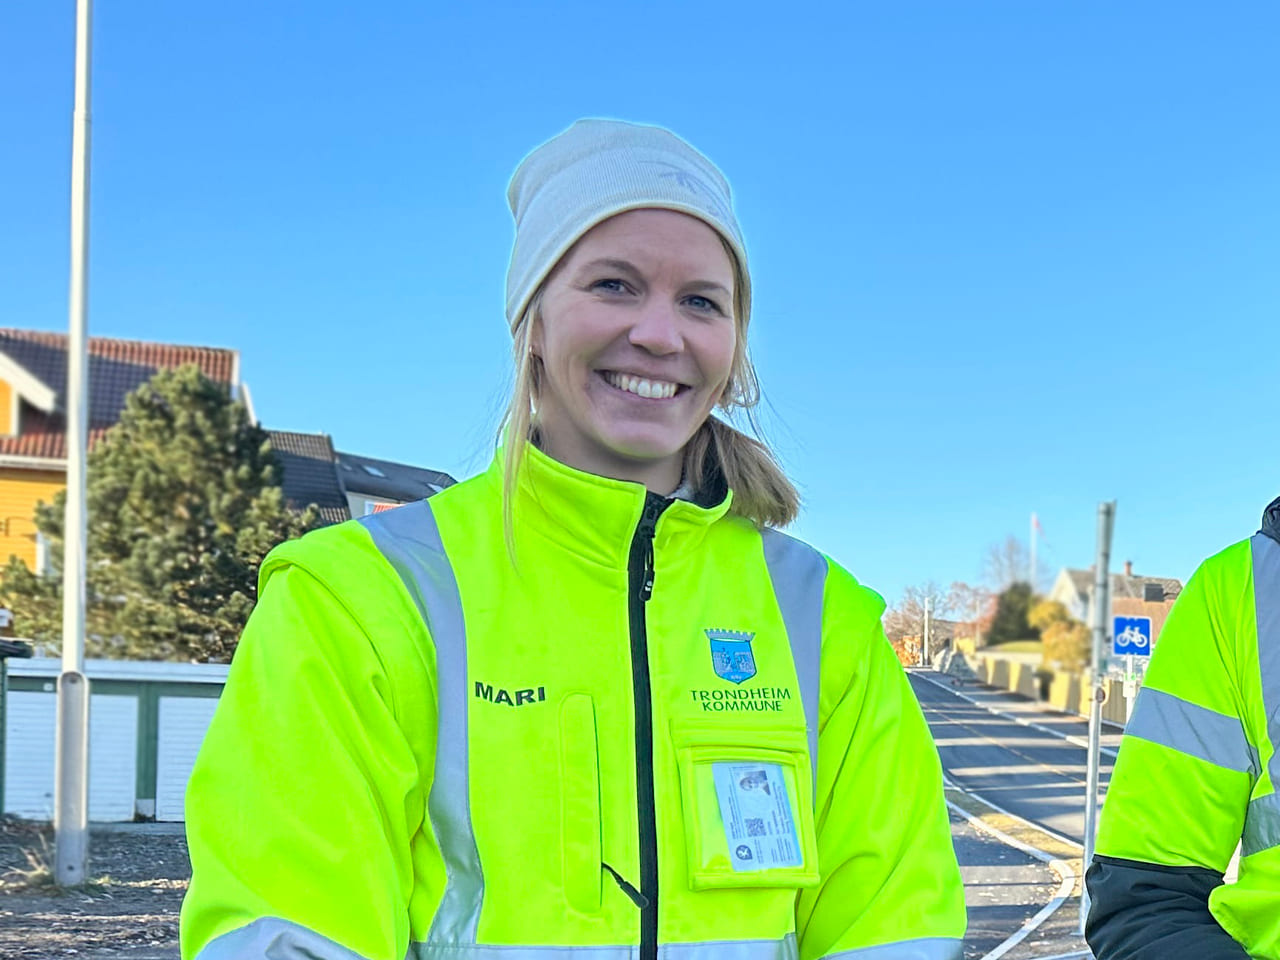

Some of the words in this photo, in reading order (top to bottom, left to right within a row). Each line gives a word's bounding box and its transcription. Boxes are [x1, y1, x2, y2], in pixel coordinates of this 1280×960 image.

[475, 681, 545, 707] MARI
[691, 688, 791, 701] TRONDHEIM
[702, 700, 784, 712] KOMMUNE
